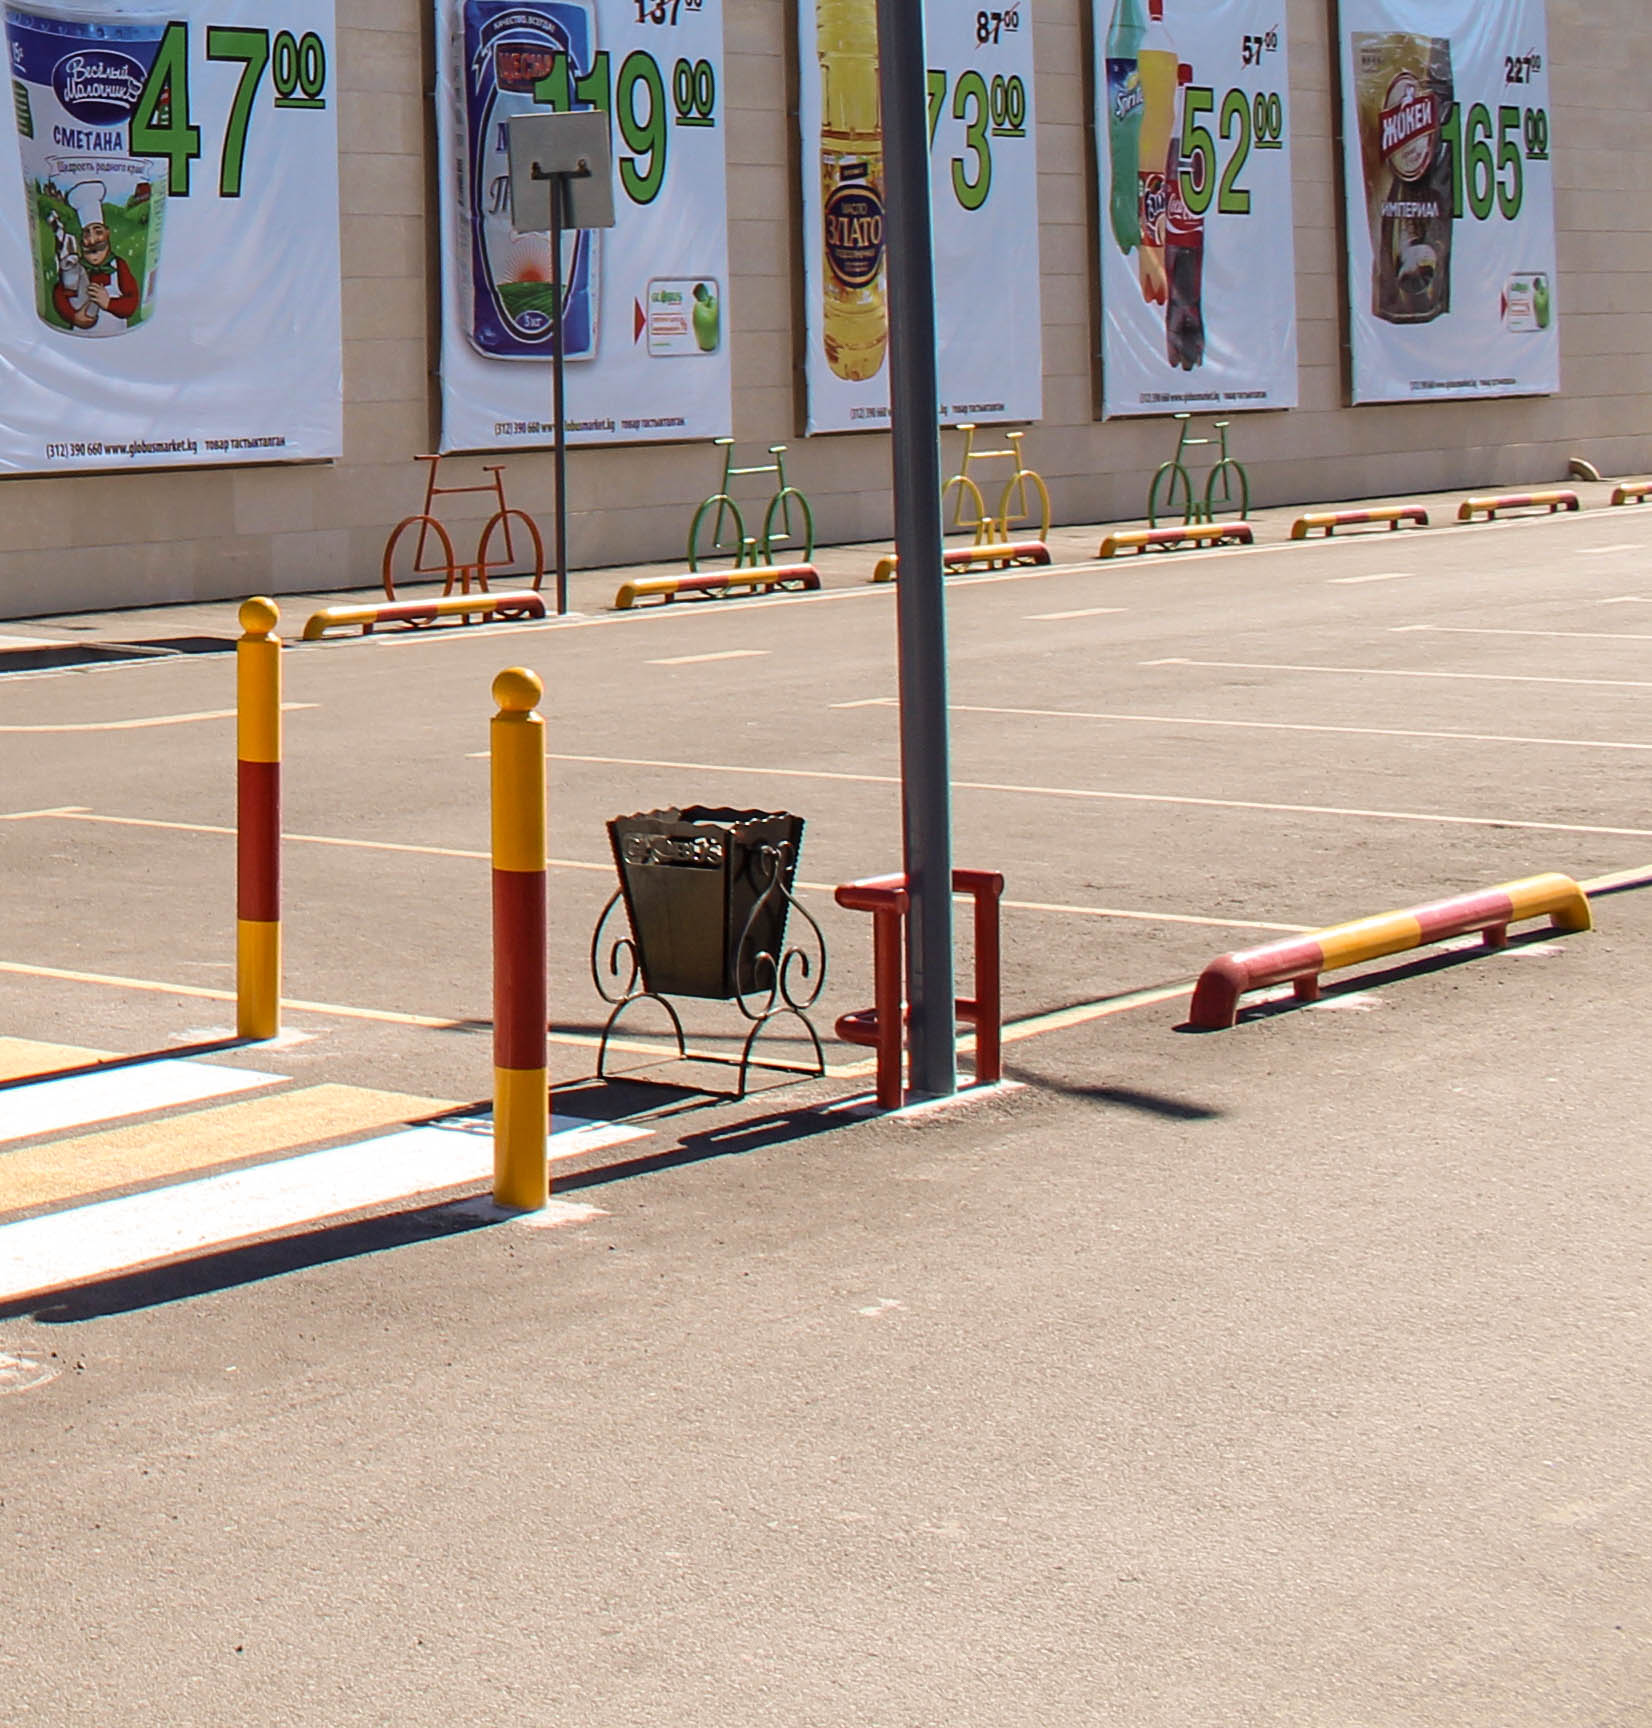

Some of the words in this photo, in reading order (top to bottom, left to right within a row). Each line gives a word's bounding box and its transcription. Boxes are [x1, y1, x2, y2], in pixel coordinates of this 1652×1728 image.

[1382, 99, 1432, 150] ЖОКЕЙ
[53, 125, 123, 151] СМЕТАНА
[1381, 201, 1439, 218] ИМПЕРИАЛ
[828, 215, 882, 247] ЗЛАТО
[46, 443, 68, 459] (312)
[70, 443, 85, 456] 390
[87, 442, 103, 456] 660
[104, 438, 197, 458] www.globusmarket.kg
[204, 439, 229, 453] товар
